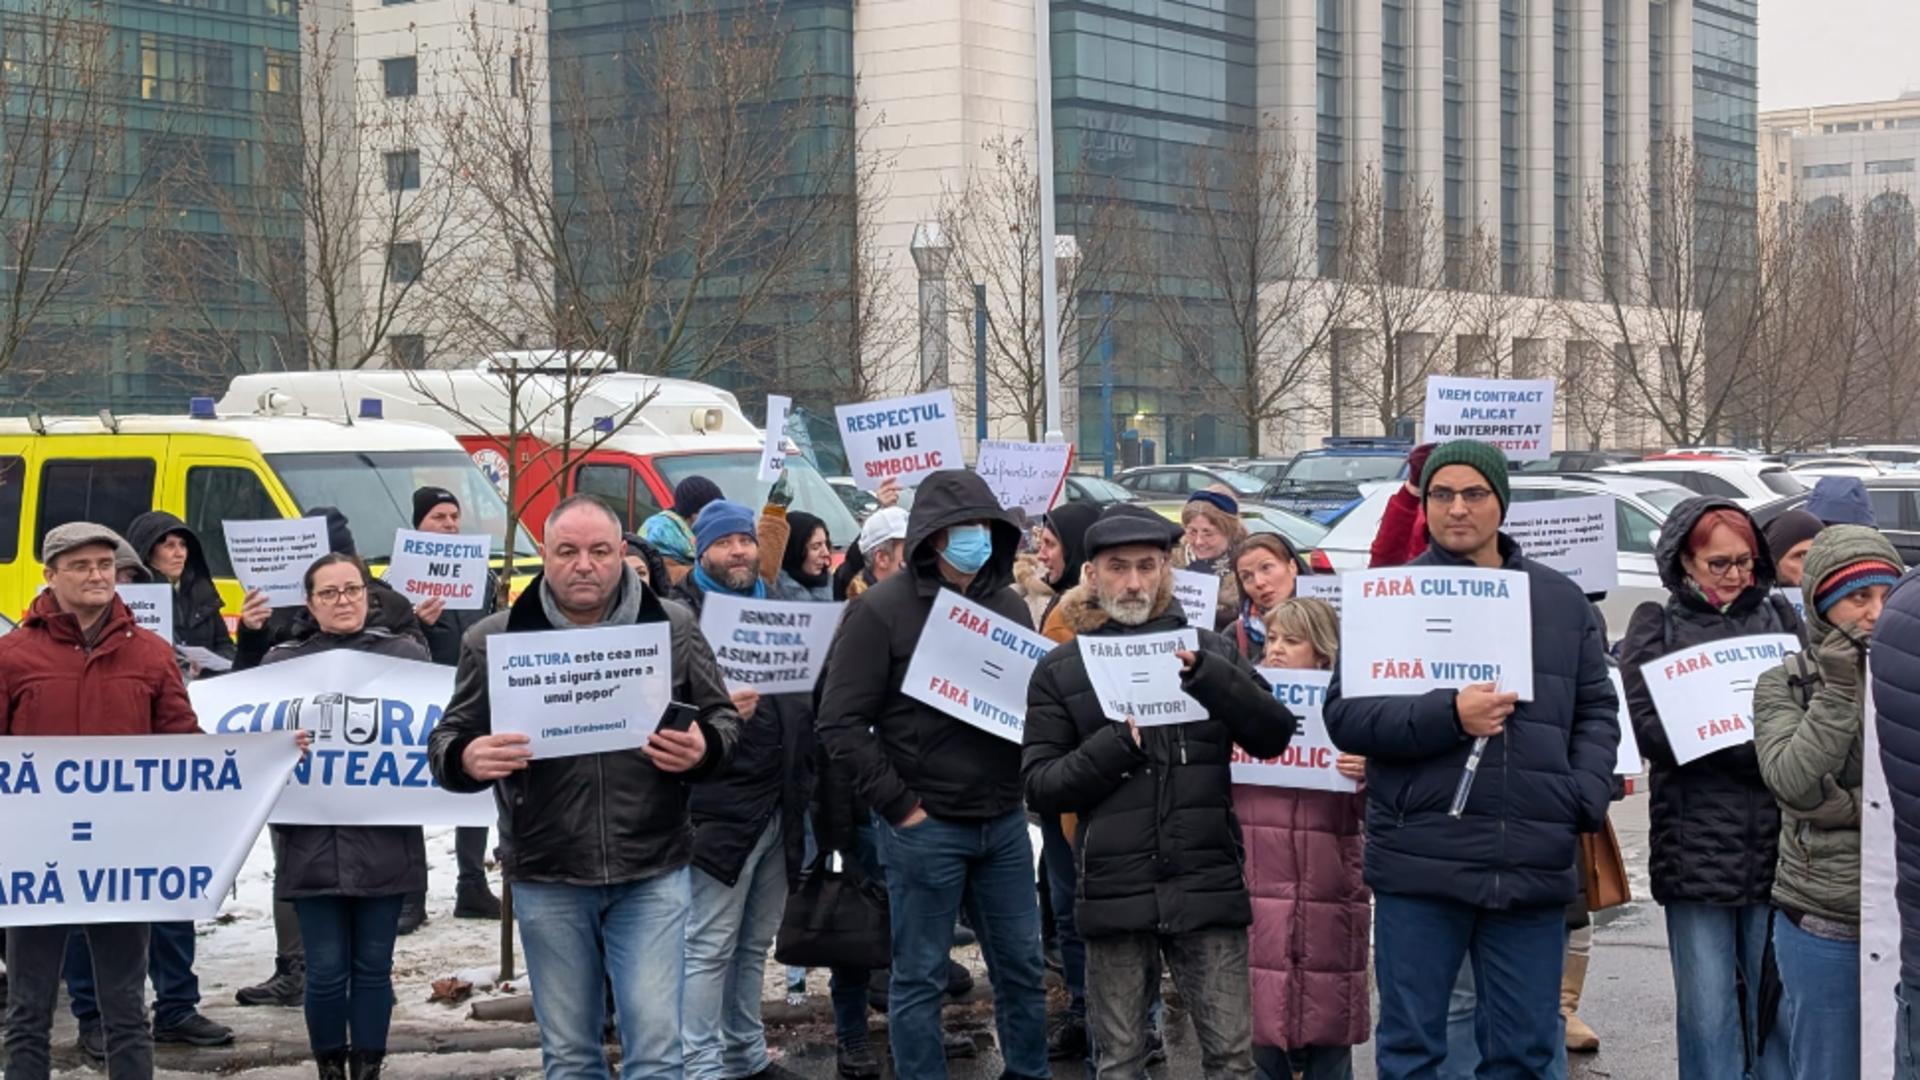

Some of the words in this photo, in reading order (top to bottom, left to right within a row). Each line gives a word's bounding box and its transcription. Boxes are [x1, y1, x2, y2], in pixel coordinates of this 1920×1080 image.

[1438, 388, 1471, 401] VREM
[1473, 391, 1543, 402] CONTRACT
[846, 403, 946, 433] RESPECTUL
[1461, 407, 1516, 419] APLICAT
[1434, 424, 1451, 436] NU
[1454, 424, 1542, 436] INTERPRETAT
[877, 433, 901, 452] NU
[905, 431, 917, 448] E
[864, 450, 943, 477] SIMBOLIC
[403, 539, 484, 559] RESPECTUL
[427, 562, 450, 577] NU
[452, 563, 462, 578] E
[405, 579, 474, 598] SIMBOLIC
[1363, 576, 1416, 598] FĂRĂ
[1420, 579, 1510, 599] CULTURĂ
[740, 609, 812, 628] IGNORATI
[948, 606, 991, 638] FĂRĂ
[991, 627, 1049, 662] CULTUR
[574, 649, 604, 664] este
[607, 649, 632, 660] cea
[634, 644, 659, 657] mai
[1090, 642, 1123, 658] FĂRĂ
[1125, 637, 1186, 657] CULTURĂ
[1371, 658, 1426, 680] FĂRĂ
[1430, 662, 1501, 681] VIITOR!
[1664, 652, 1713, 680] FĂRĂ
[508, 674, 541, 688] bună
[545, 672, 557, 685] si
[559, 670, 602, 687] sigură
[605, 667, 642, 679] avere
[645, 666, 654, 675] a
[543, 690, 573, 704] unui
[929, 676, 970, 707] FĂRĂ
[1138, 700, 1187, 716] VIITOR!
[1697, 714, 1746, 741] FĂRĂ
[55, 749, 242, 794] CULTURĂ
[78, 866, 215, 903] VIITOR
